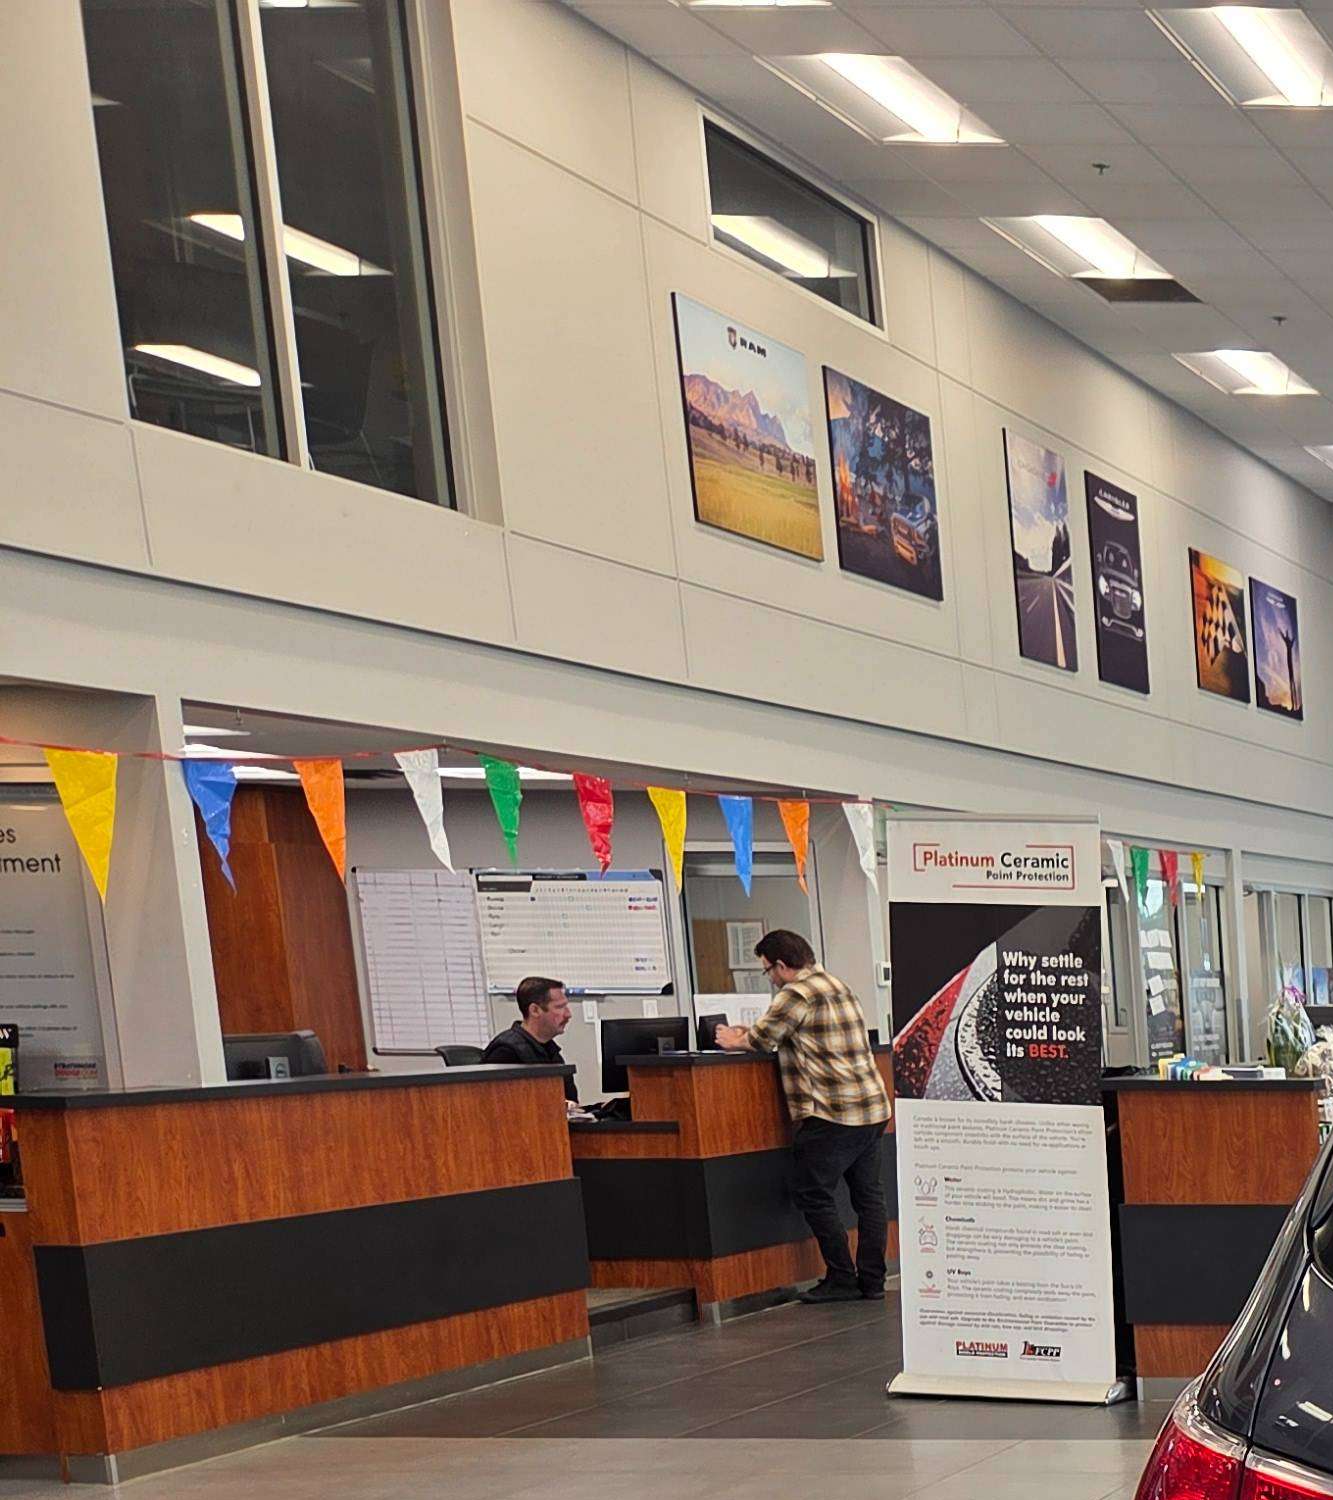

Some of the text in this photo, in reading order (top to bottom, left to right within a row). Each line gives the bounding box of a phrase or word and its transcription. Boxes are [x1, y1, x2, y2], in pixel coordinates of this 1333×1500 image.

[739, 336, 767, 358] RAM
[923, 850, 1070, 869] Platinum Ceramic
[986, 870, 1070, 882] Paint Protection
[1002, 951, 1083, 971] Why settle
[1003, 968, 1089, 987] for the rest
[1004, 987, 1086, 1008] when your
[1004, 1006, 1061, 1022] vehicle
[1005, 1024, 1086, 1042] could look
[1006, 1041, 1069, 1059] its BEST.
[955, 1340, 1009, 1352] PLATINUM
